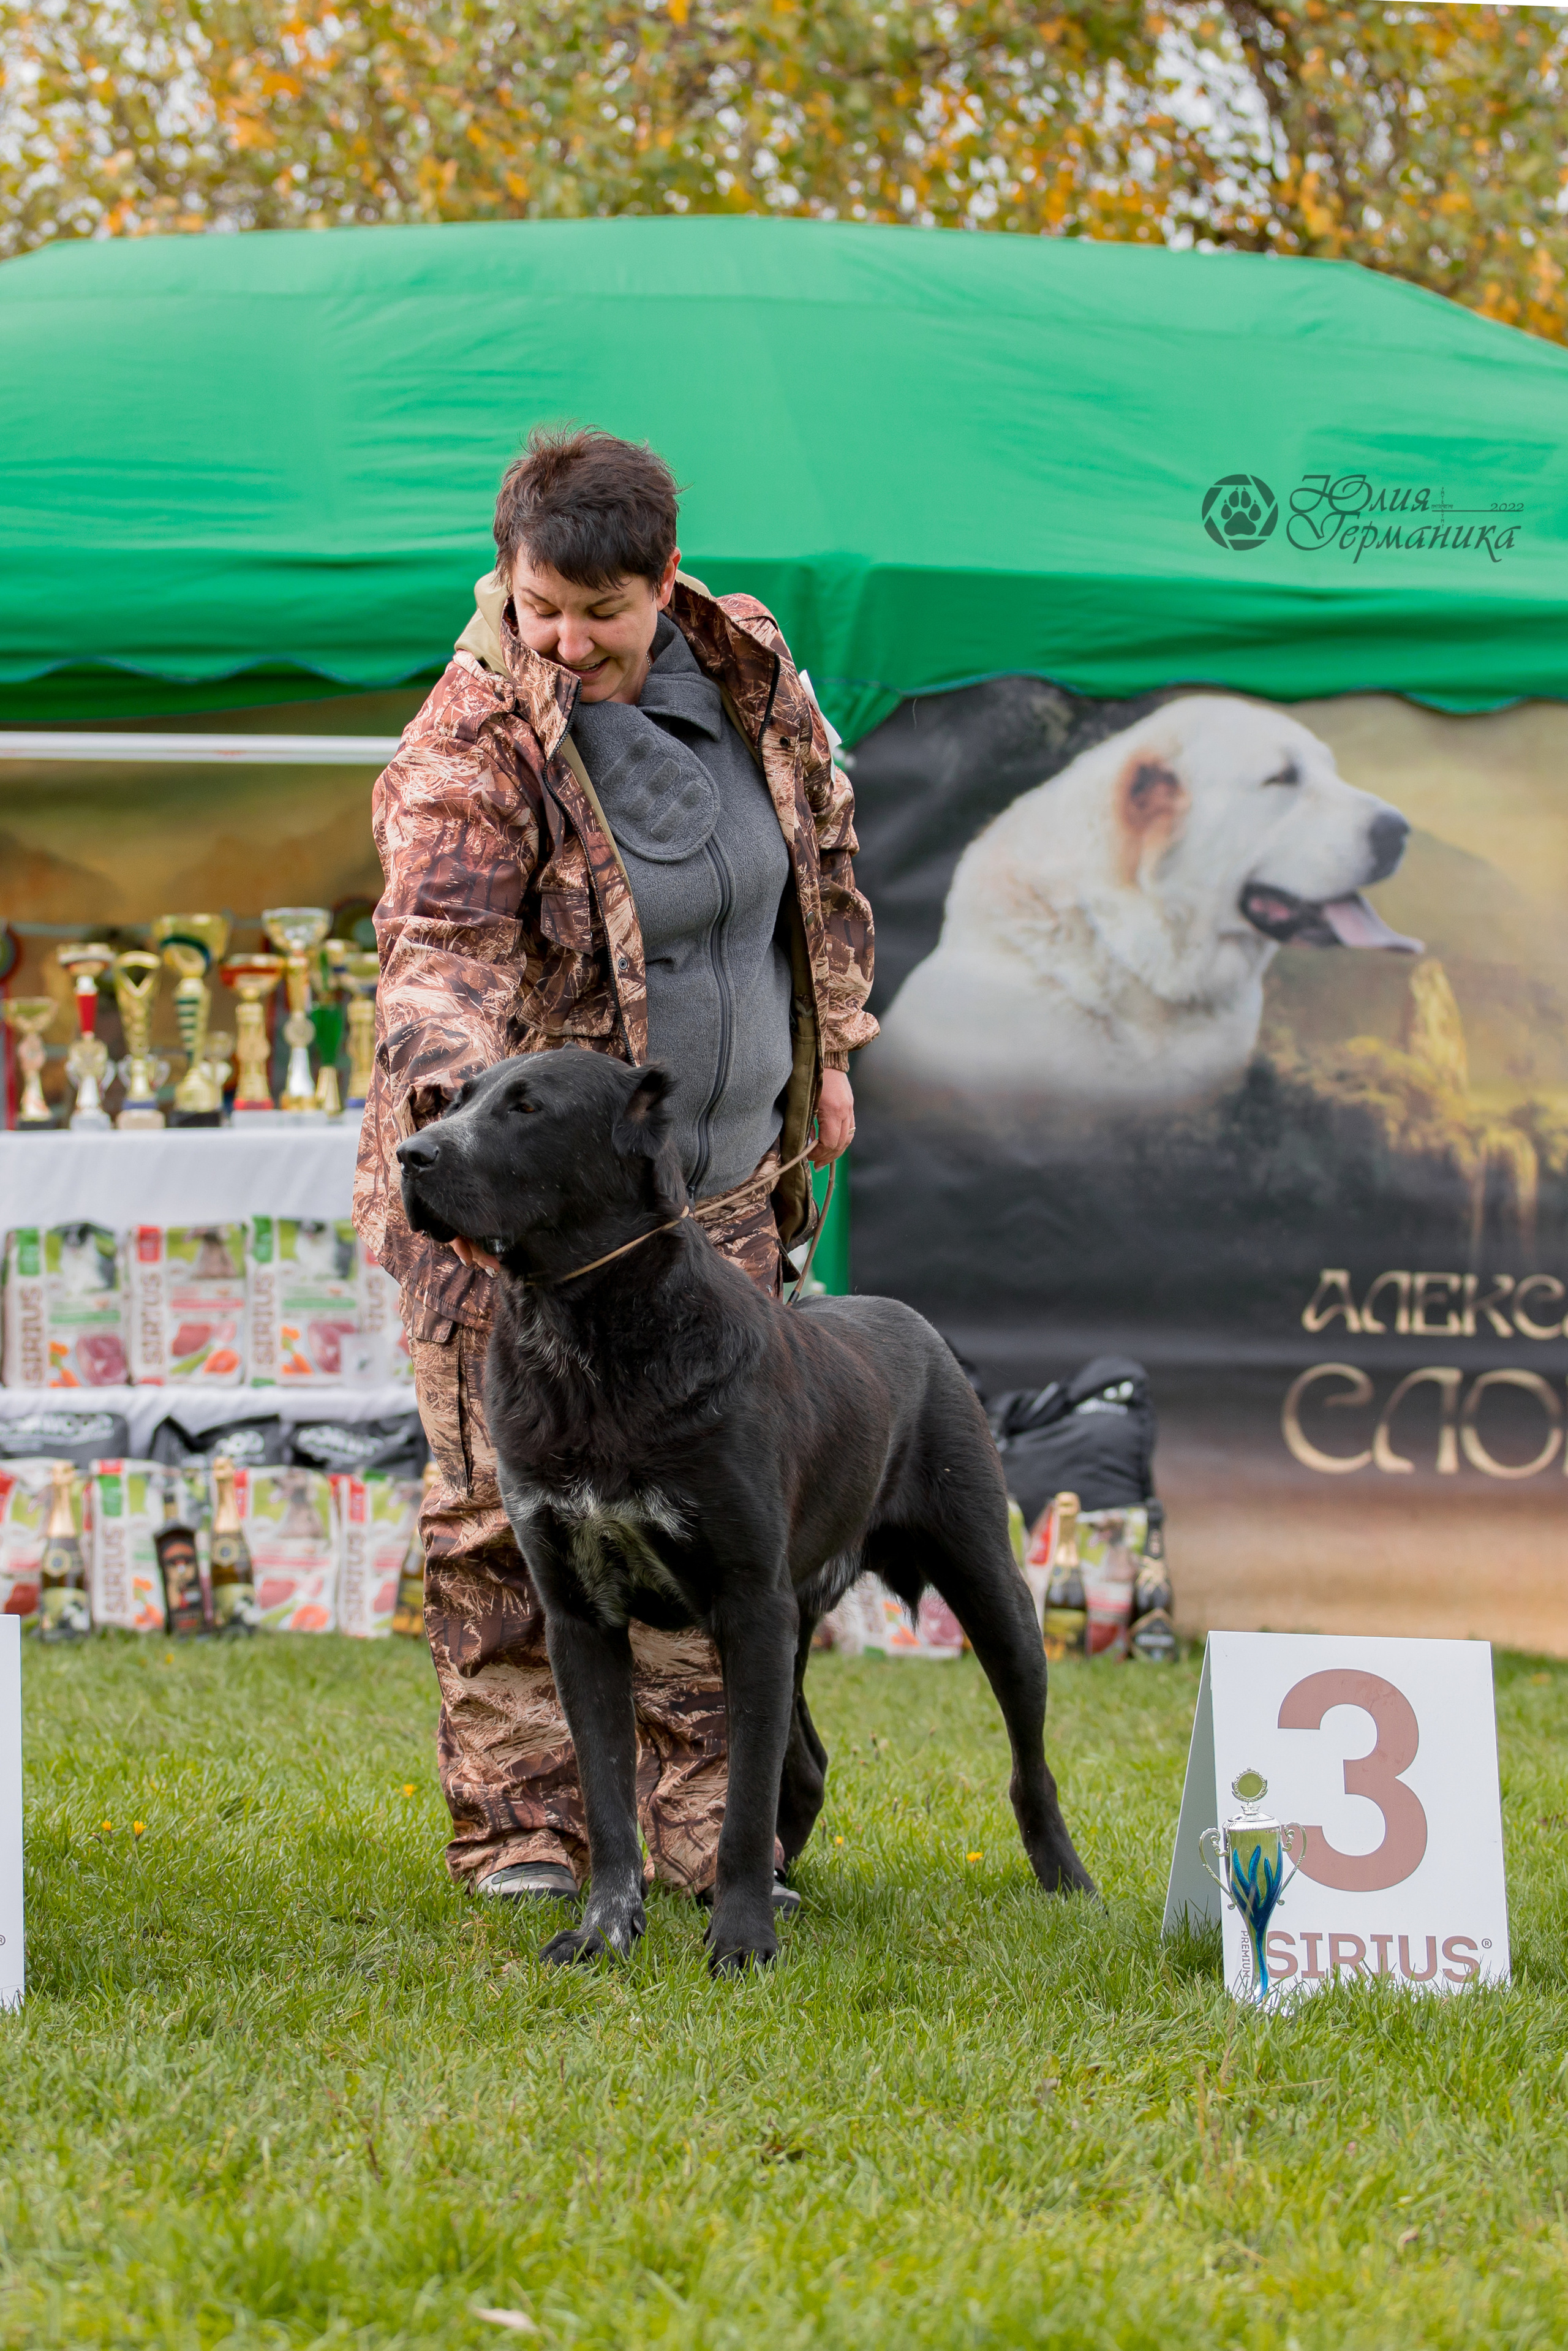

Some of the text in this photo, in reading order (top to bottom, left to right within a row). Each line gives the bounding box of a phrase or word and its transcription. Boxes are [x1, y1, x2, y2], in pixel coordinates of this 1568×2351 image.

[20, 1287, 44, 1382] SIRIUS
[141, 1273, 163, 1365] SIRIUS
[254, 1273, 276, 1365] SIRIUS
[1302, 1267, 1568, 1340] АЛЕКС
[1283, 1362, 1568, 1479] СЛО
[1278, 1668, 1428, 1892] 3
[1241, 1930, 1251, 1978] PREMIUM
